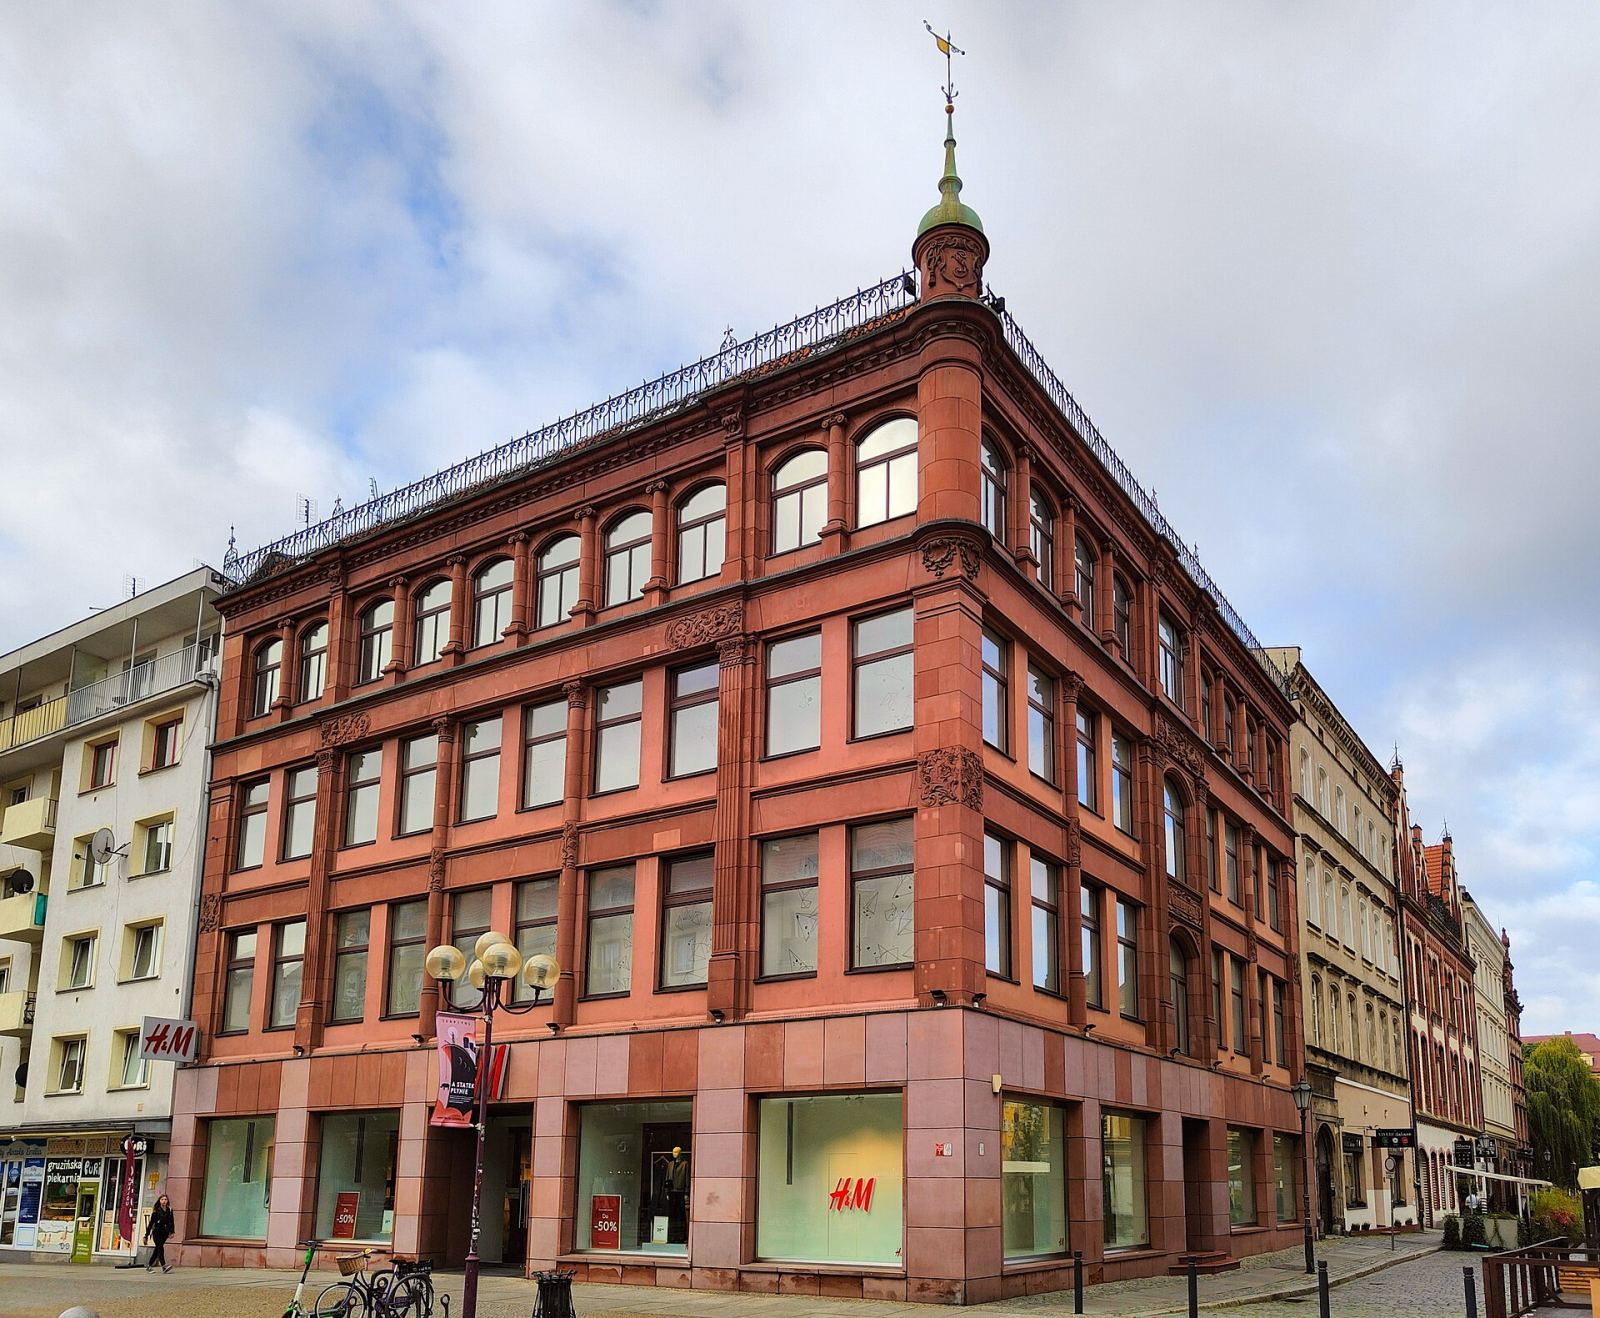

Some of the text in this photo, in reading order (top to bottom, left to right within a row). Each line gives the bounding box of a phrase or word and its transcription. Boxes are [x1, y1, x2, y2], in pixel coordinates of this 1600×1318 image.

[144, 1023, 195, 1057] H&M
[48, 1159, 82, 1173] gruzińska
[47, 1172, 81, 1186] piekarnia
[829, 1177, 875, 1213] H&M
[336, 1214, 354, 1224] -50%
[593, 1220, 618, 1232] -50%
